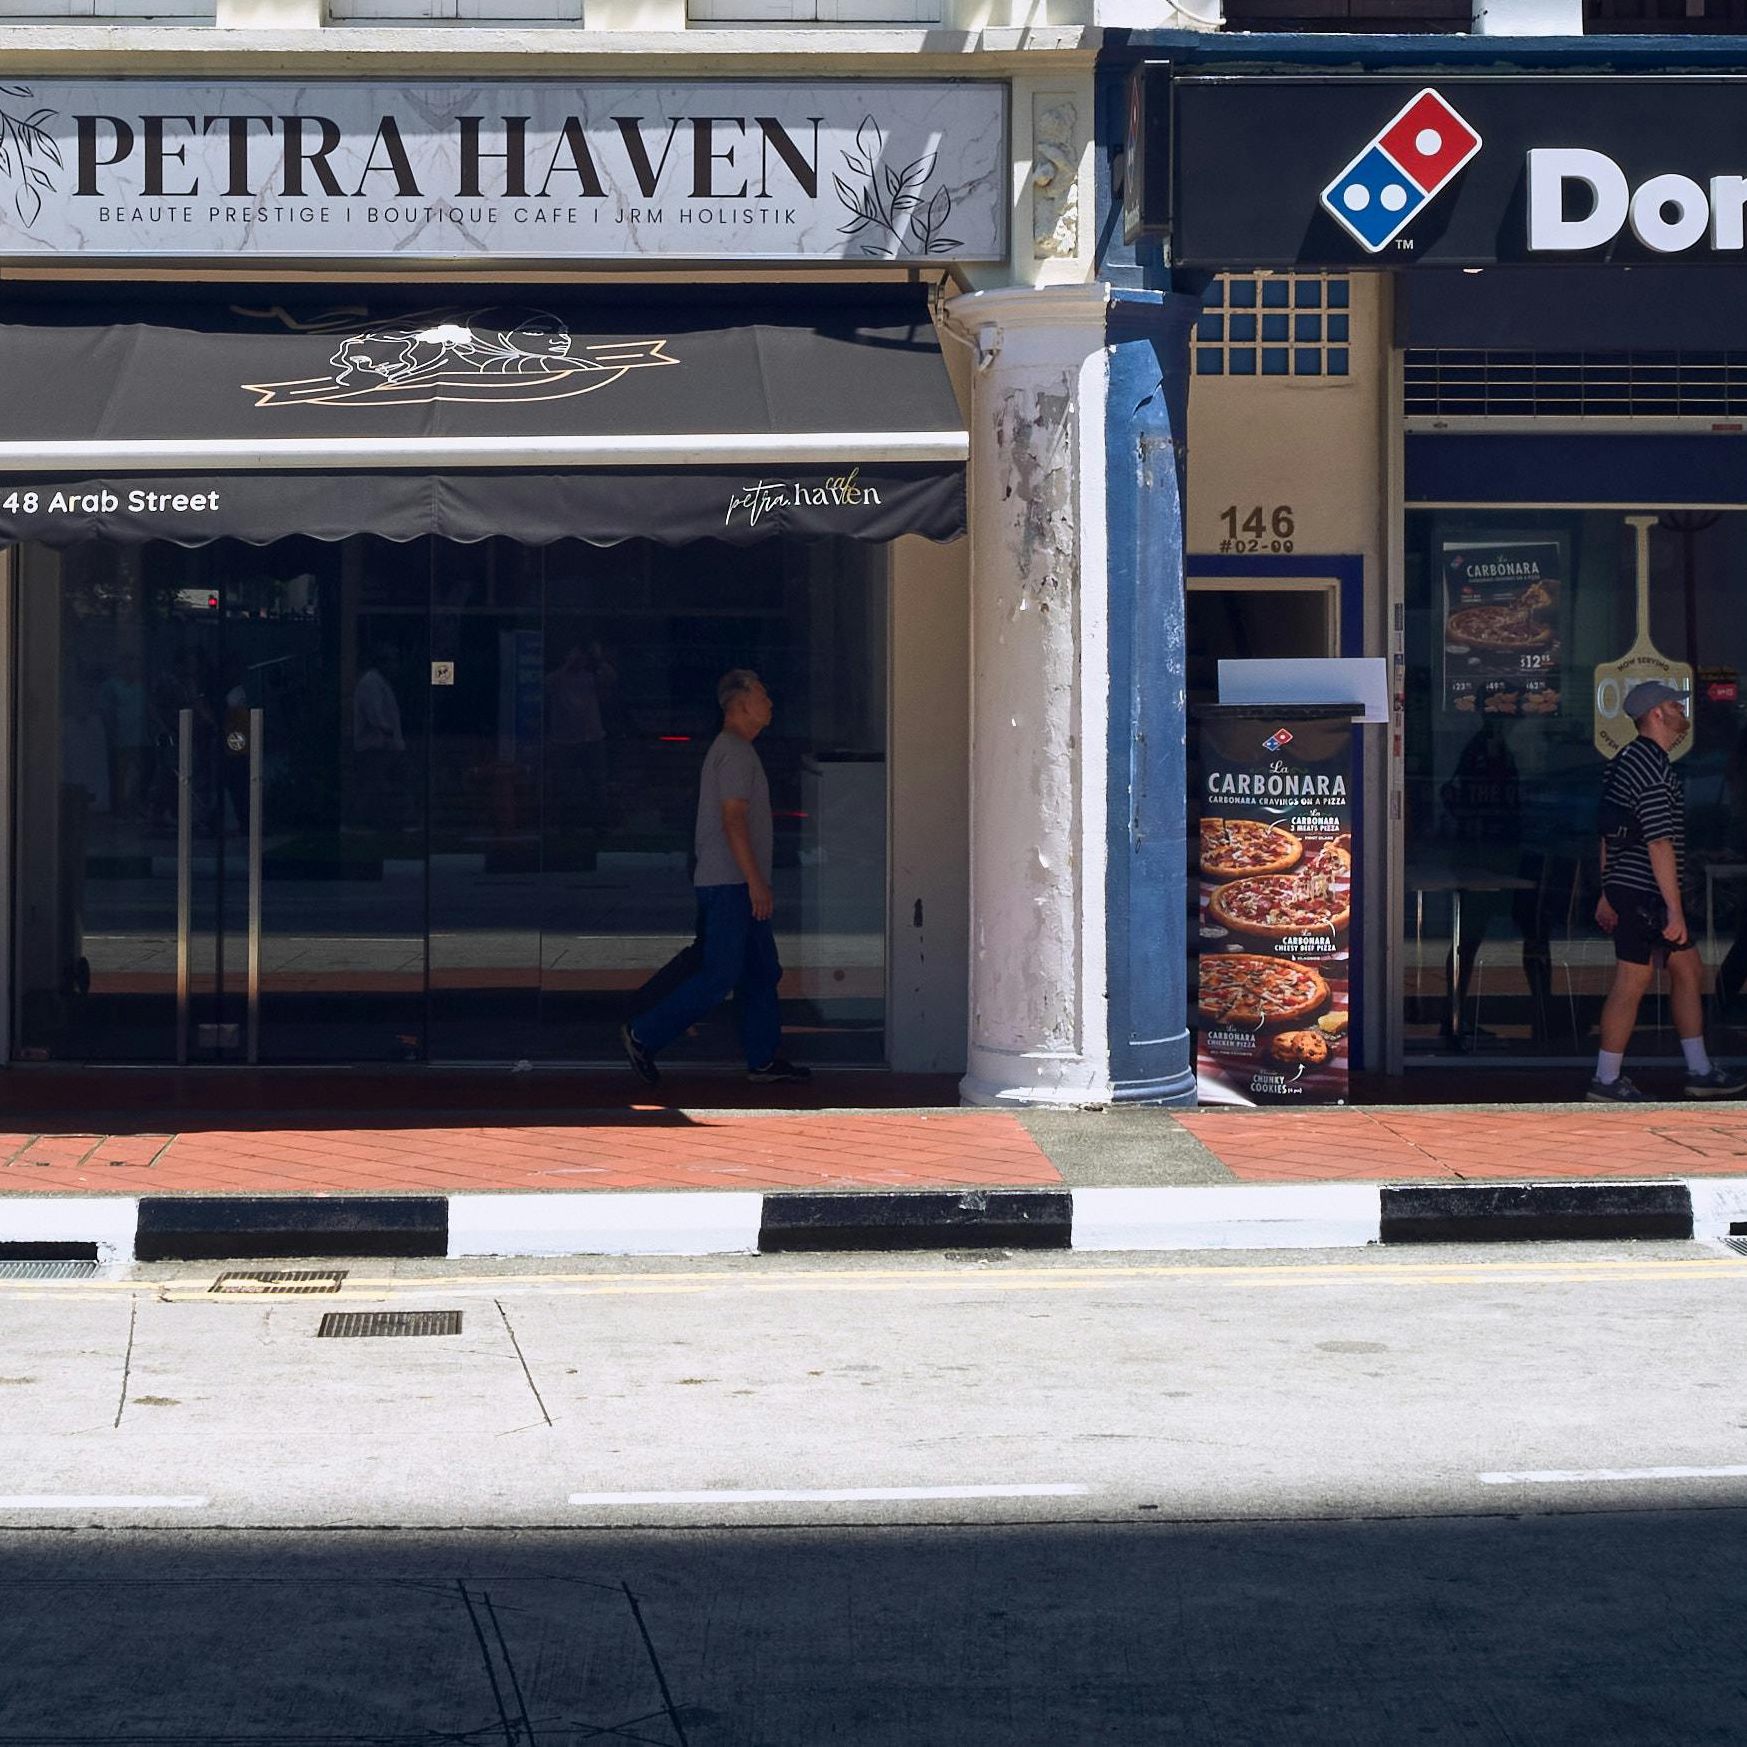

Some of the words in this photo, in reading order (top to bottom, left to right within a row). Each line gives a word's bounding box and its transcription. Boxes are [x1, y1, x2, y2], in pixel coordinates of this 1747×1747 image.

[71, 115, 425, 197] PETRA
[453, 115, 825, 199] HAVEN
[99, 206, 193, 223] BEAUTE
[209, 206, 331, 223] PRESTIGE
[368, 207, 498, 225] BOUTIQUE
[514, 207, 578, 224] CAFE
[614, 208, 664, 224] JRM
[679, 208, 797, 224] HOLISTIK
[47, 489, 119, 514] Arab
[128, 489, 220, 513] Street
[1220, 505, 1295, 539] 146
[1466, 561, 1540, 579] CARBONARA
[1269, 760, 1289, 774] La
[1208, 773, 1347, 796] CARBONARA
[1208, 795, 1257, 805] CARBONARA
[1258, 797, 1299, 806] CRAVINGS
[1300, 797, 1313, 805] ON
[1323, 797, 1346, 805] PIZZA
[1291, 816, 1340, 825] CARBONARA
[1296, 824, 1319, 832] MEATS
[1319, 824, 1340, 832] PIZZA
[1282, 936, 1331, 945] CARBONARA
[1300, 944, 1315, 952] BEEF
[1316, 944, 1337, 952] PIZZA
[1208, 1031, 1256, 1042] CARBONARA
[1207, 1039, 1235, 1047] CHICKEN
[1253, 1074, 1285, 1085] CHUNKY
[1250, 1082, 1287, 1094] COOKIES
